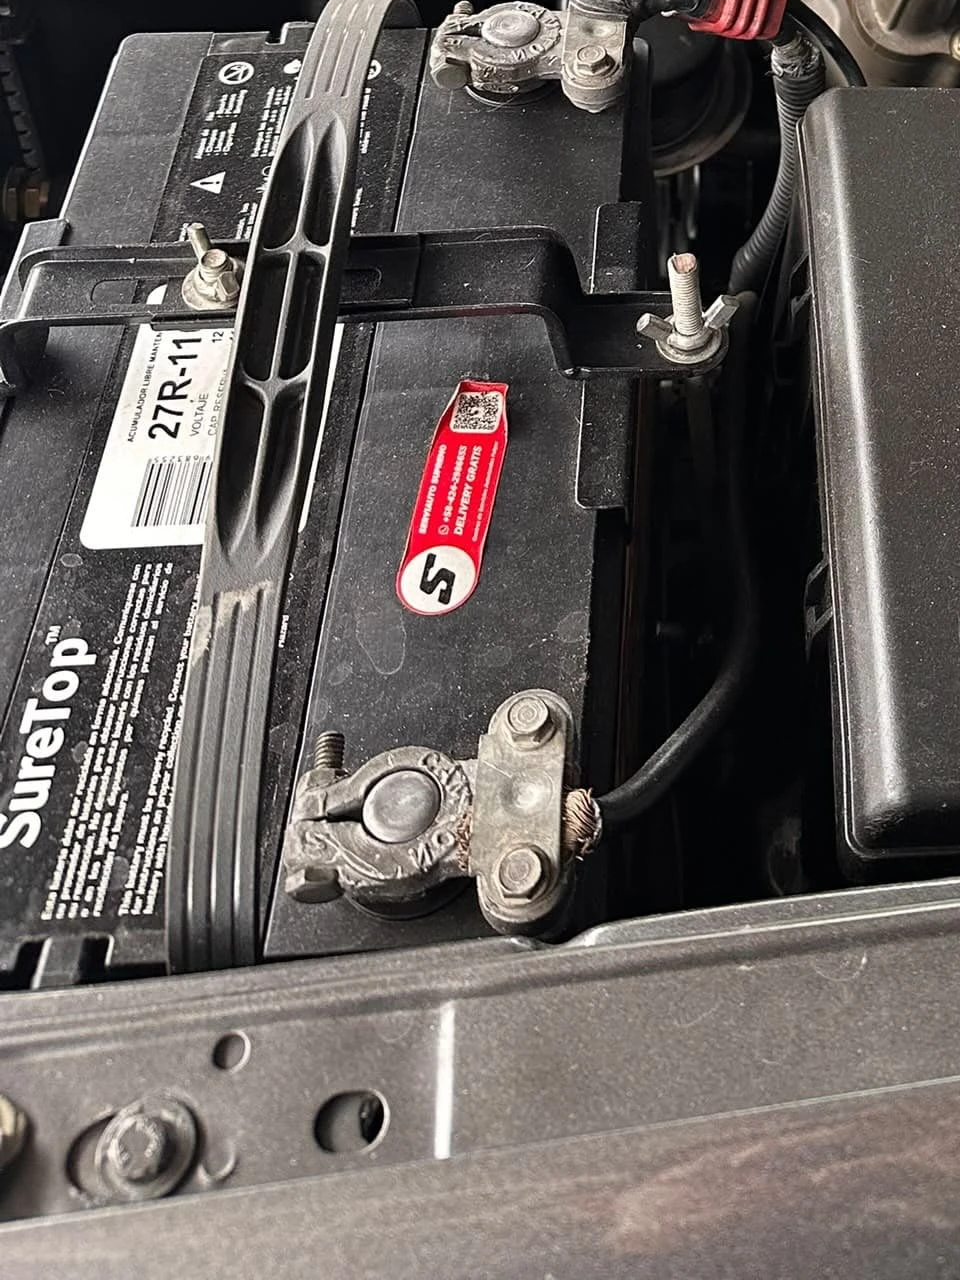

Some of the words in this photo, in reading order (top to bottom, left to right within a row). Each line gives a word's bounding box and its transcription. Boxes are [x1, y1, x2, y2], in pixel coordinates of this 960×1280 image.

[127, 388, 147, 442] ACUMULADOR
[143, 365, 154, 386] LIBRE
[149, 333, 162, 362] MANTEN
[190, 394, 209, 436] VOLTAJE
[454, 484, 472, 535] DELIVERY
[466, 446, 482, 482] GRATIS
